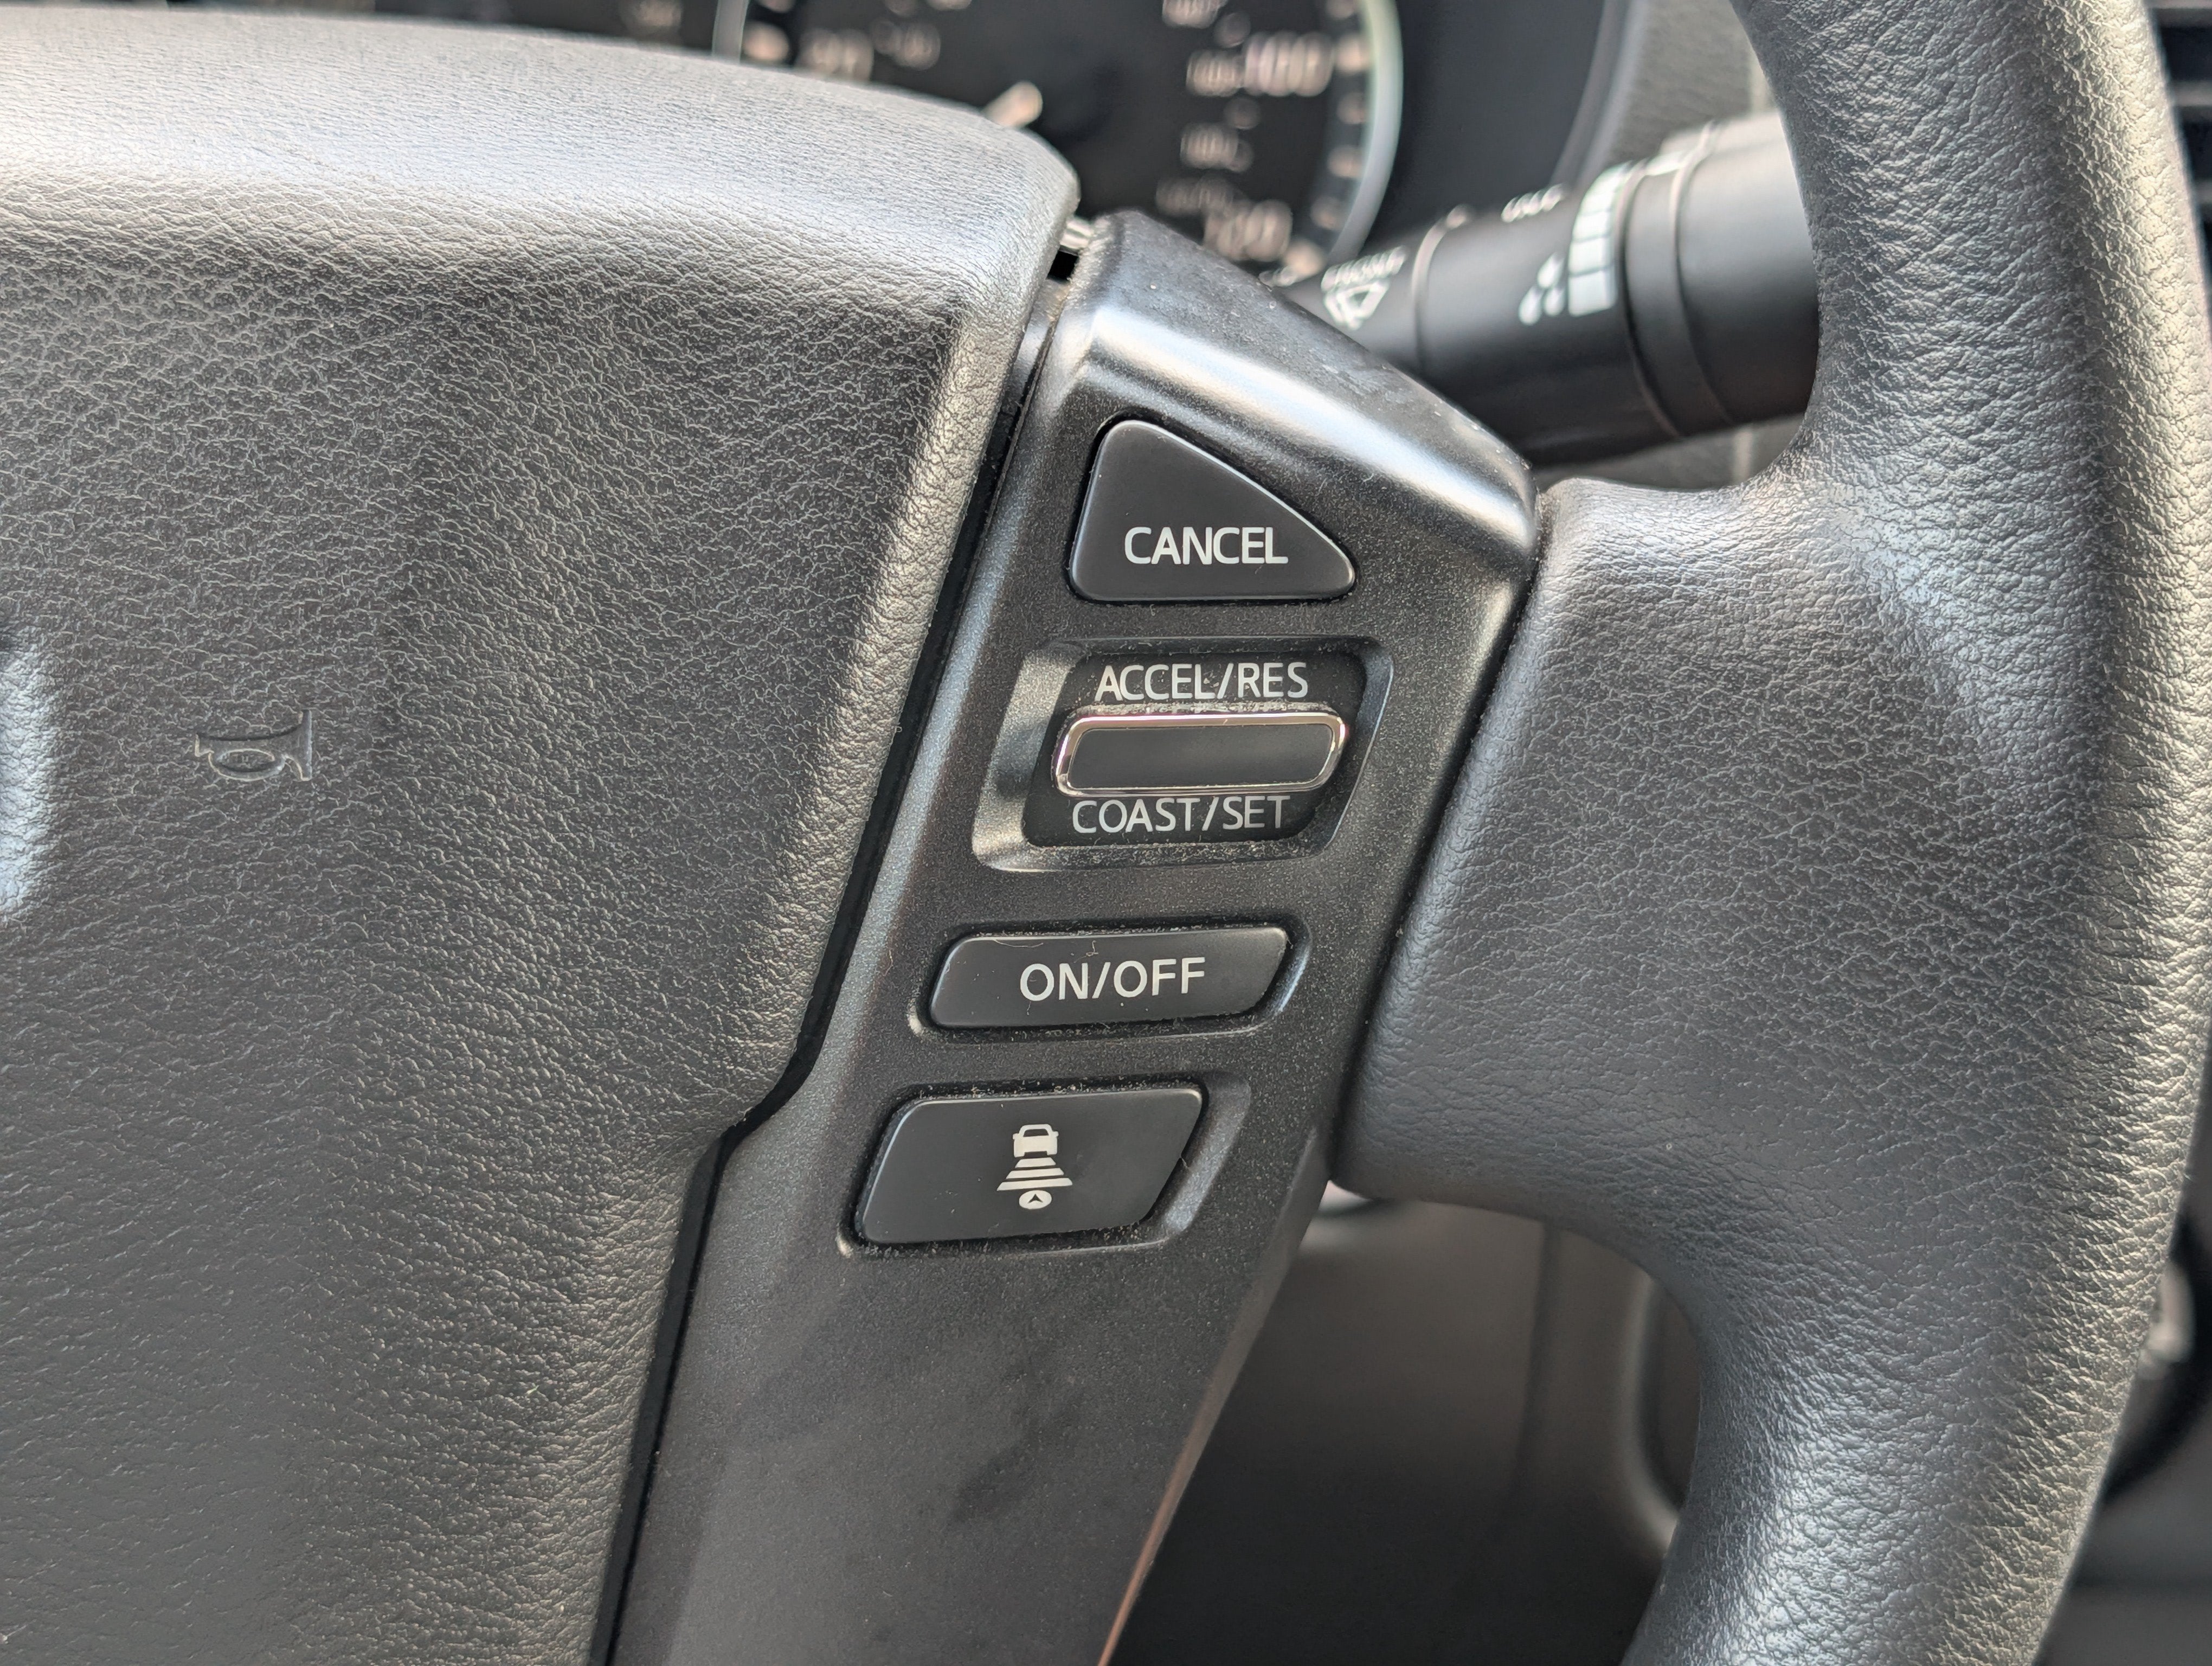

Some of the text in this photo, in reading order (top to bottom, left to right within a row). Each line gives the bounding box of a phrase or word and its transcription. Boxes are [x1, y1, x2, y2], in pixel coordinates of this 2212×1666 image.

[1124, 527, 1289, 565] CANCEL
[1095, 662, 1308, 701] ACCEL/RES
[1072, 795, 1290, 834] COAST/SET
[1020, 957, 1206, 1002] ON/OFF
